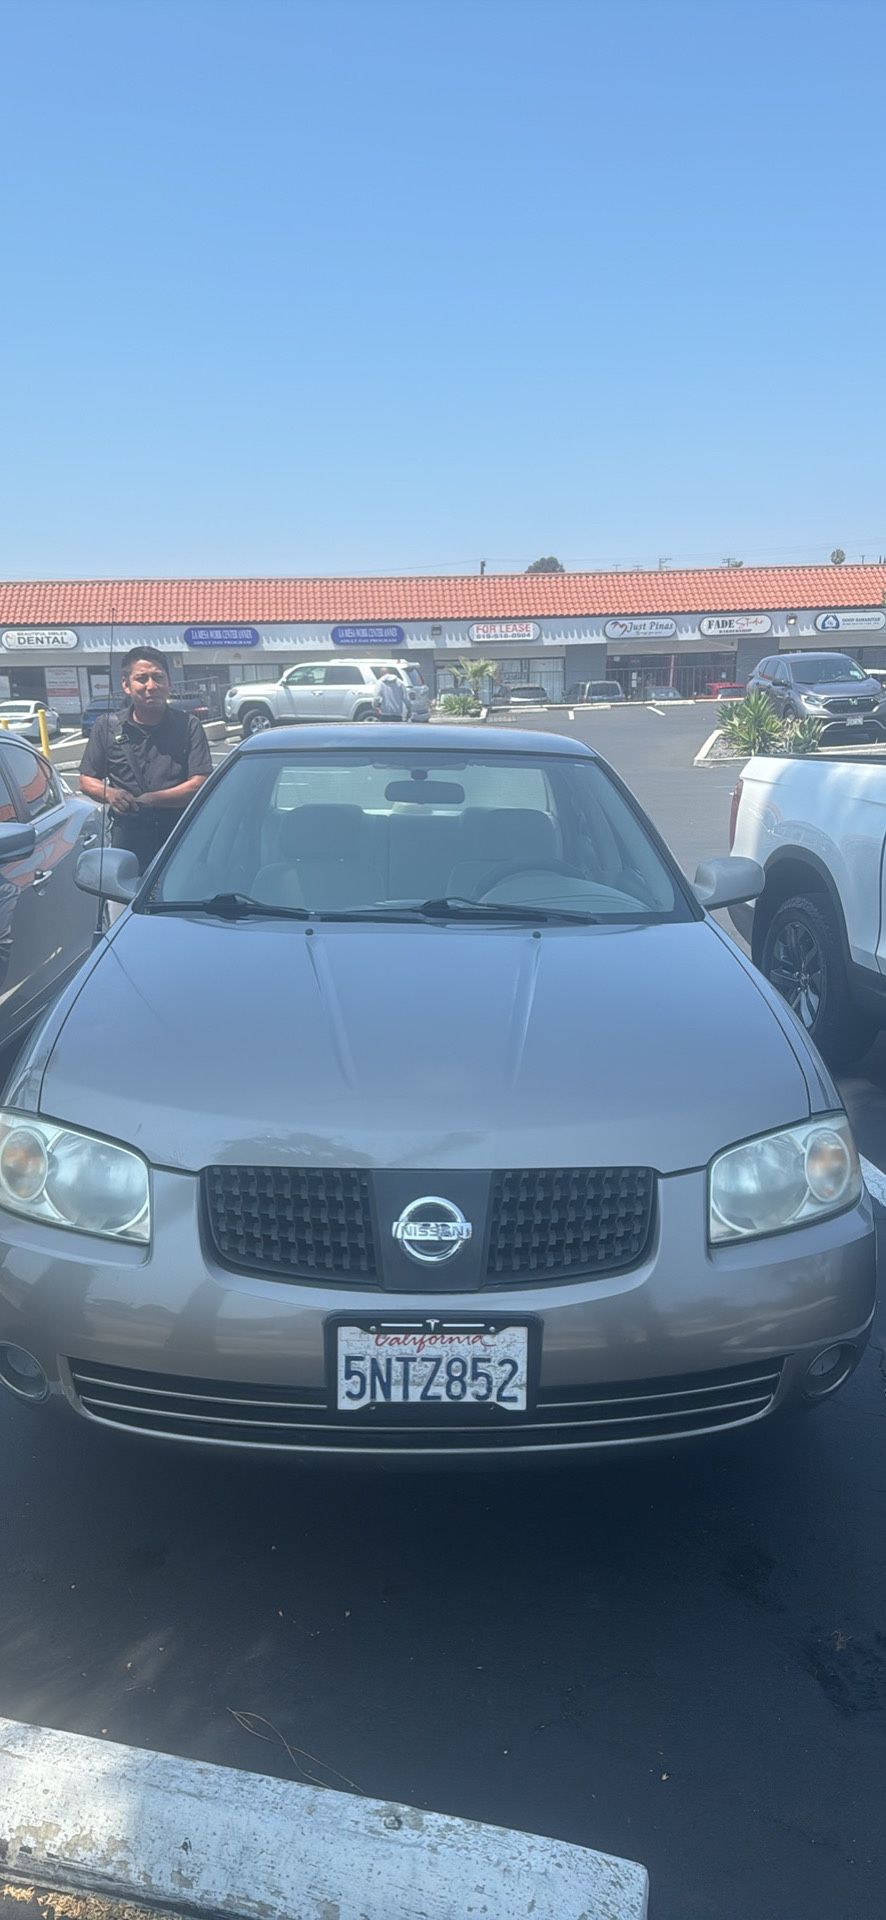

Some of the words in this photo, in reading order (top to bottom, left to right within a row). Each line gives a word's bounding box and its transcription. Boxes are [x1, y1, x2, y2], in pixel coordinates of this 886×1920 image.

[476, 625, 497, 633] FOR
[500, 624, 531, 633] LEASE
[627, 622, 646, 632] Just
[650, 621, 674, 630] Pinas
[708, 620, 735, 629] FADE
[17, 636, 69, 645] DENTAL
[401, 1223, 464, 1237] NISSAN
[375, 1333, 497, 1353] California
[344, 1355, 519, 1402] 5NTZ852
